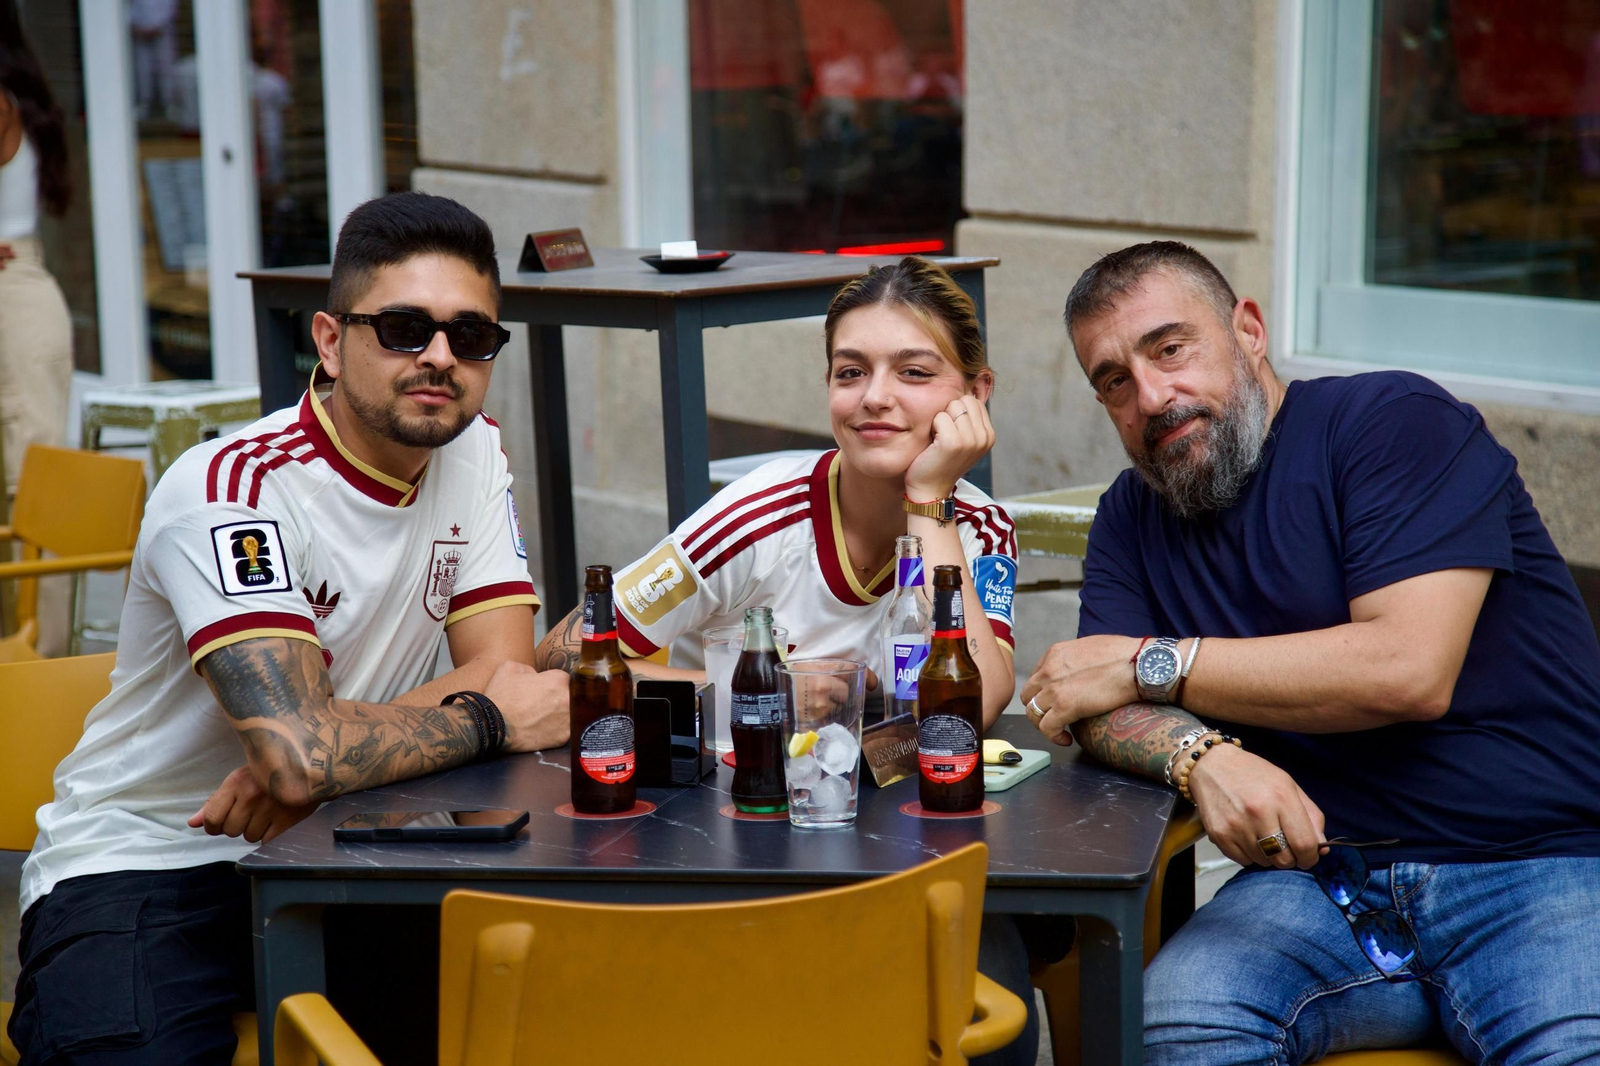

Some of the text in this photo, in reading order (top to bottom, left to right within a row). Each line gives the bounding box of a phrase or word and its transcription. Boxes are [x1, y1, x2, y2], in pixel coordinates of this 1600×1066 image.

[247, 574, 266, 582] FIFA
[985, 578, 1014, 595] Unite For
[625, 589, 645, 614] 2026
[985, 591, 1012, 607] PEACE
[990, 603, 1007, 611] FIFA
